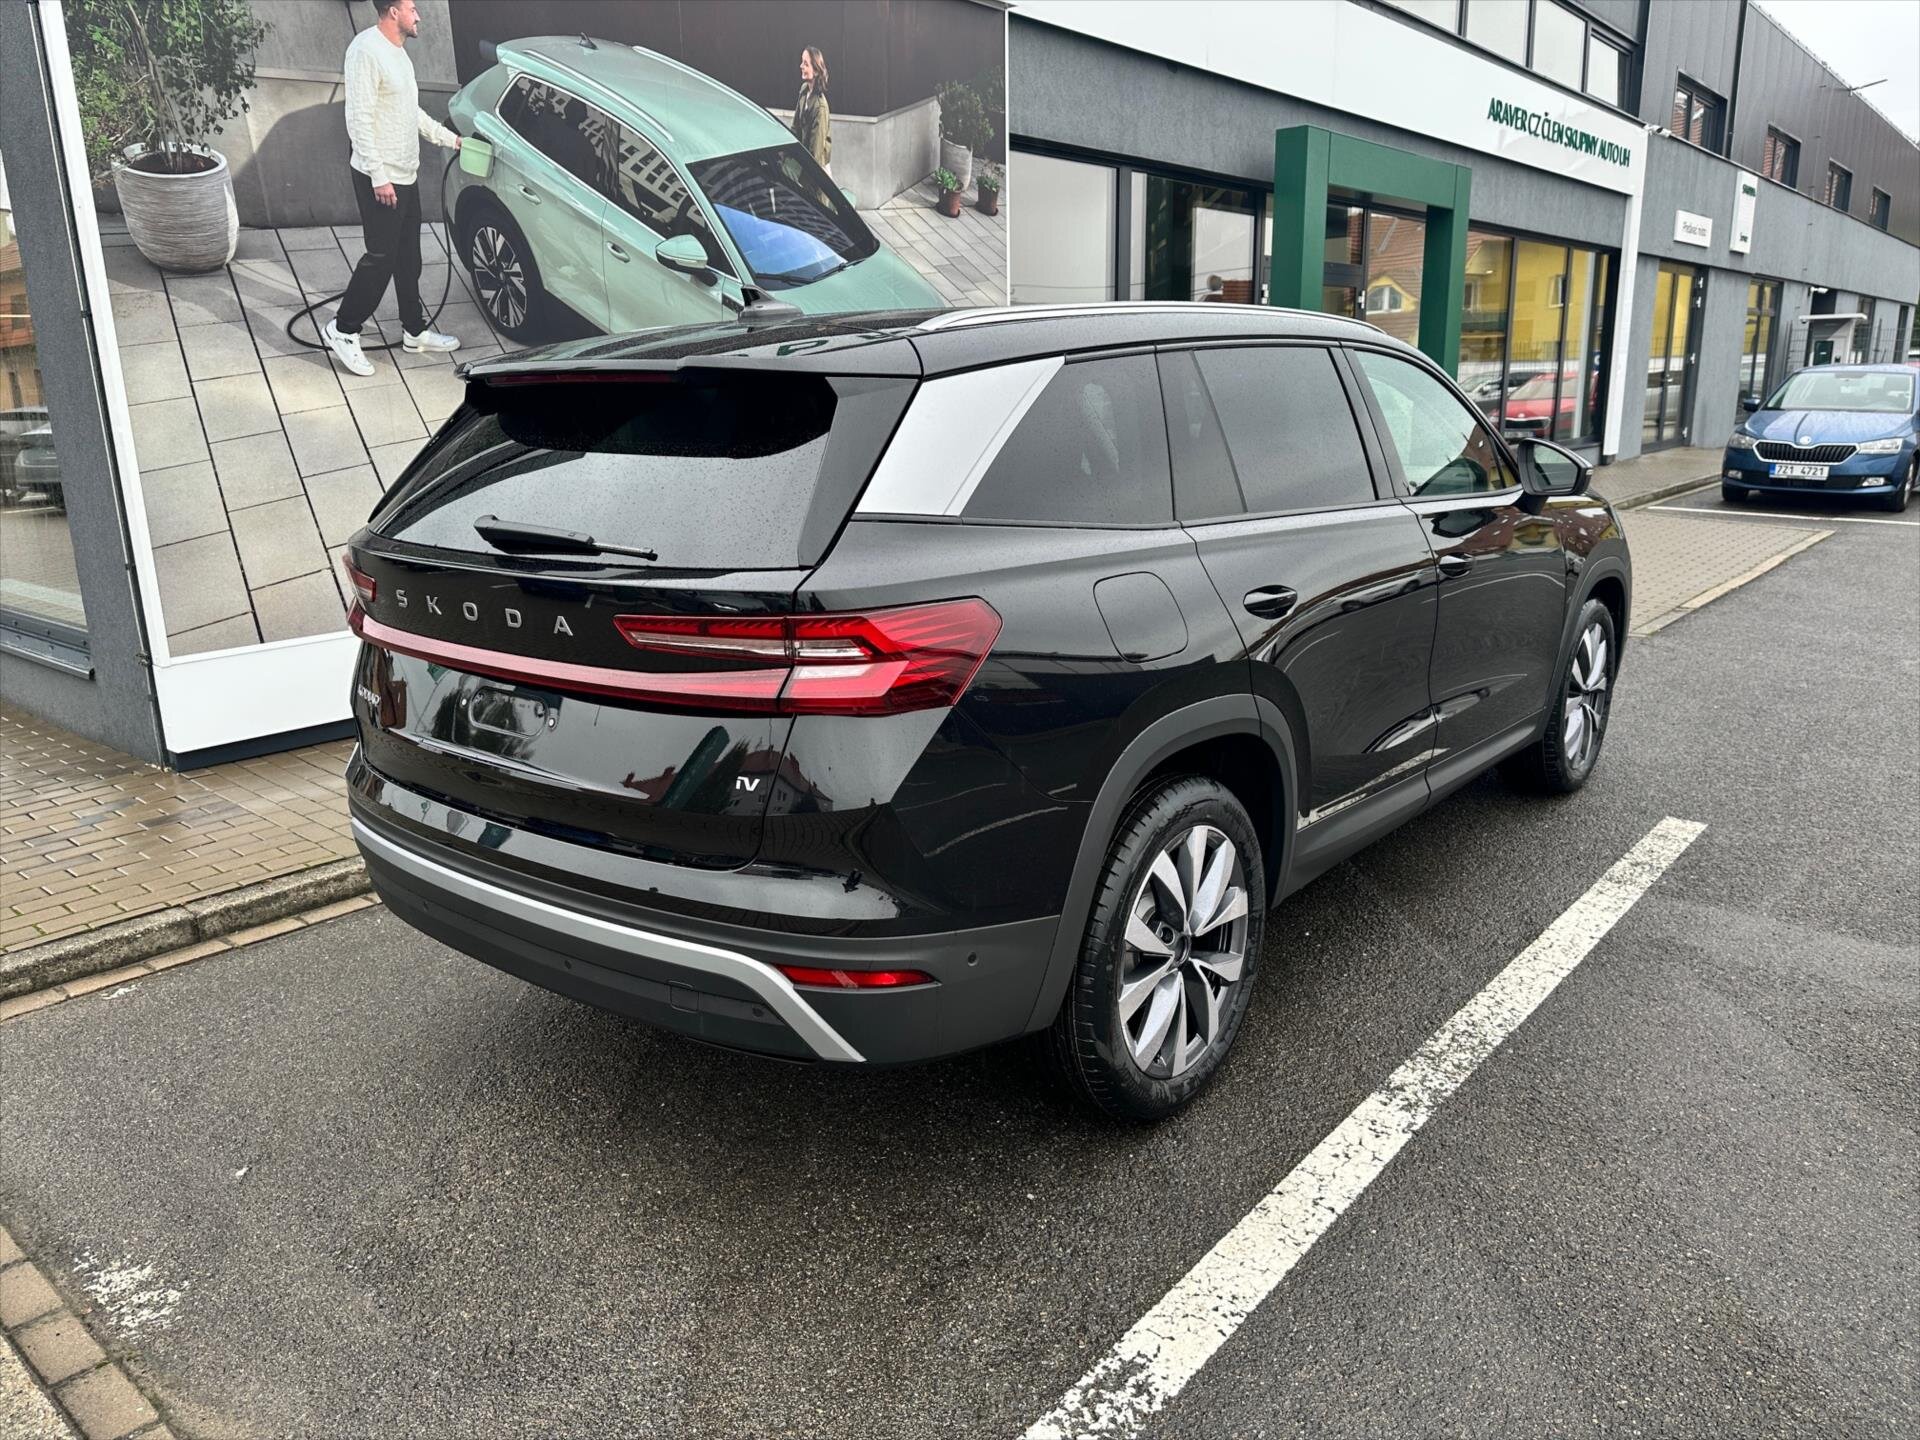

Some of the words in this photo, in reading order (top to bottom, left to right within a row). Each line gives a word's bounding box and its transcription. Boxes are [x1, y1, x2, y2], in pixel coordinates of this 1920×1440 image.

[1487, 97, 1528, 132] ARAVER
[1528, 113, 1541, 137] CZ
[1564, 126, 1599, 156] SKUPINY
[1598, 139, 1619, 164] AUTO
[1800, 466, 1824, 476] 4721
[395, 589, 574, 637] SKODA
